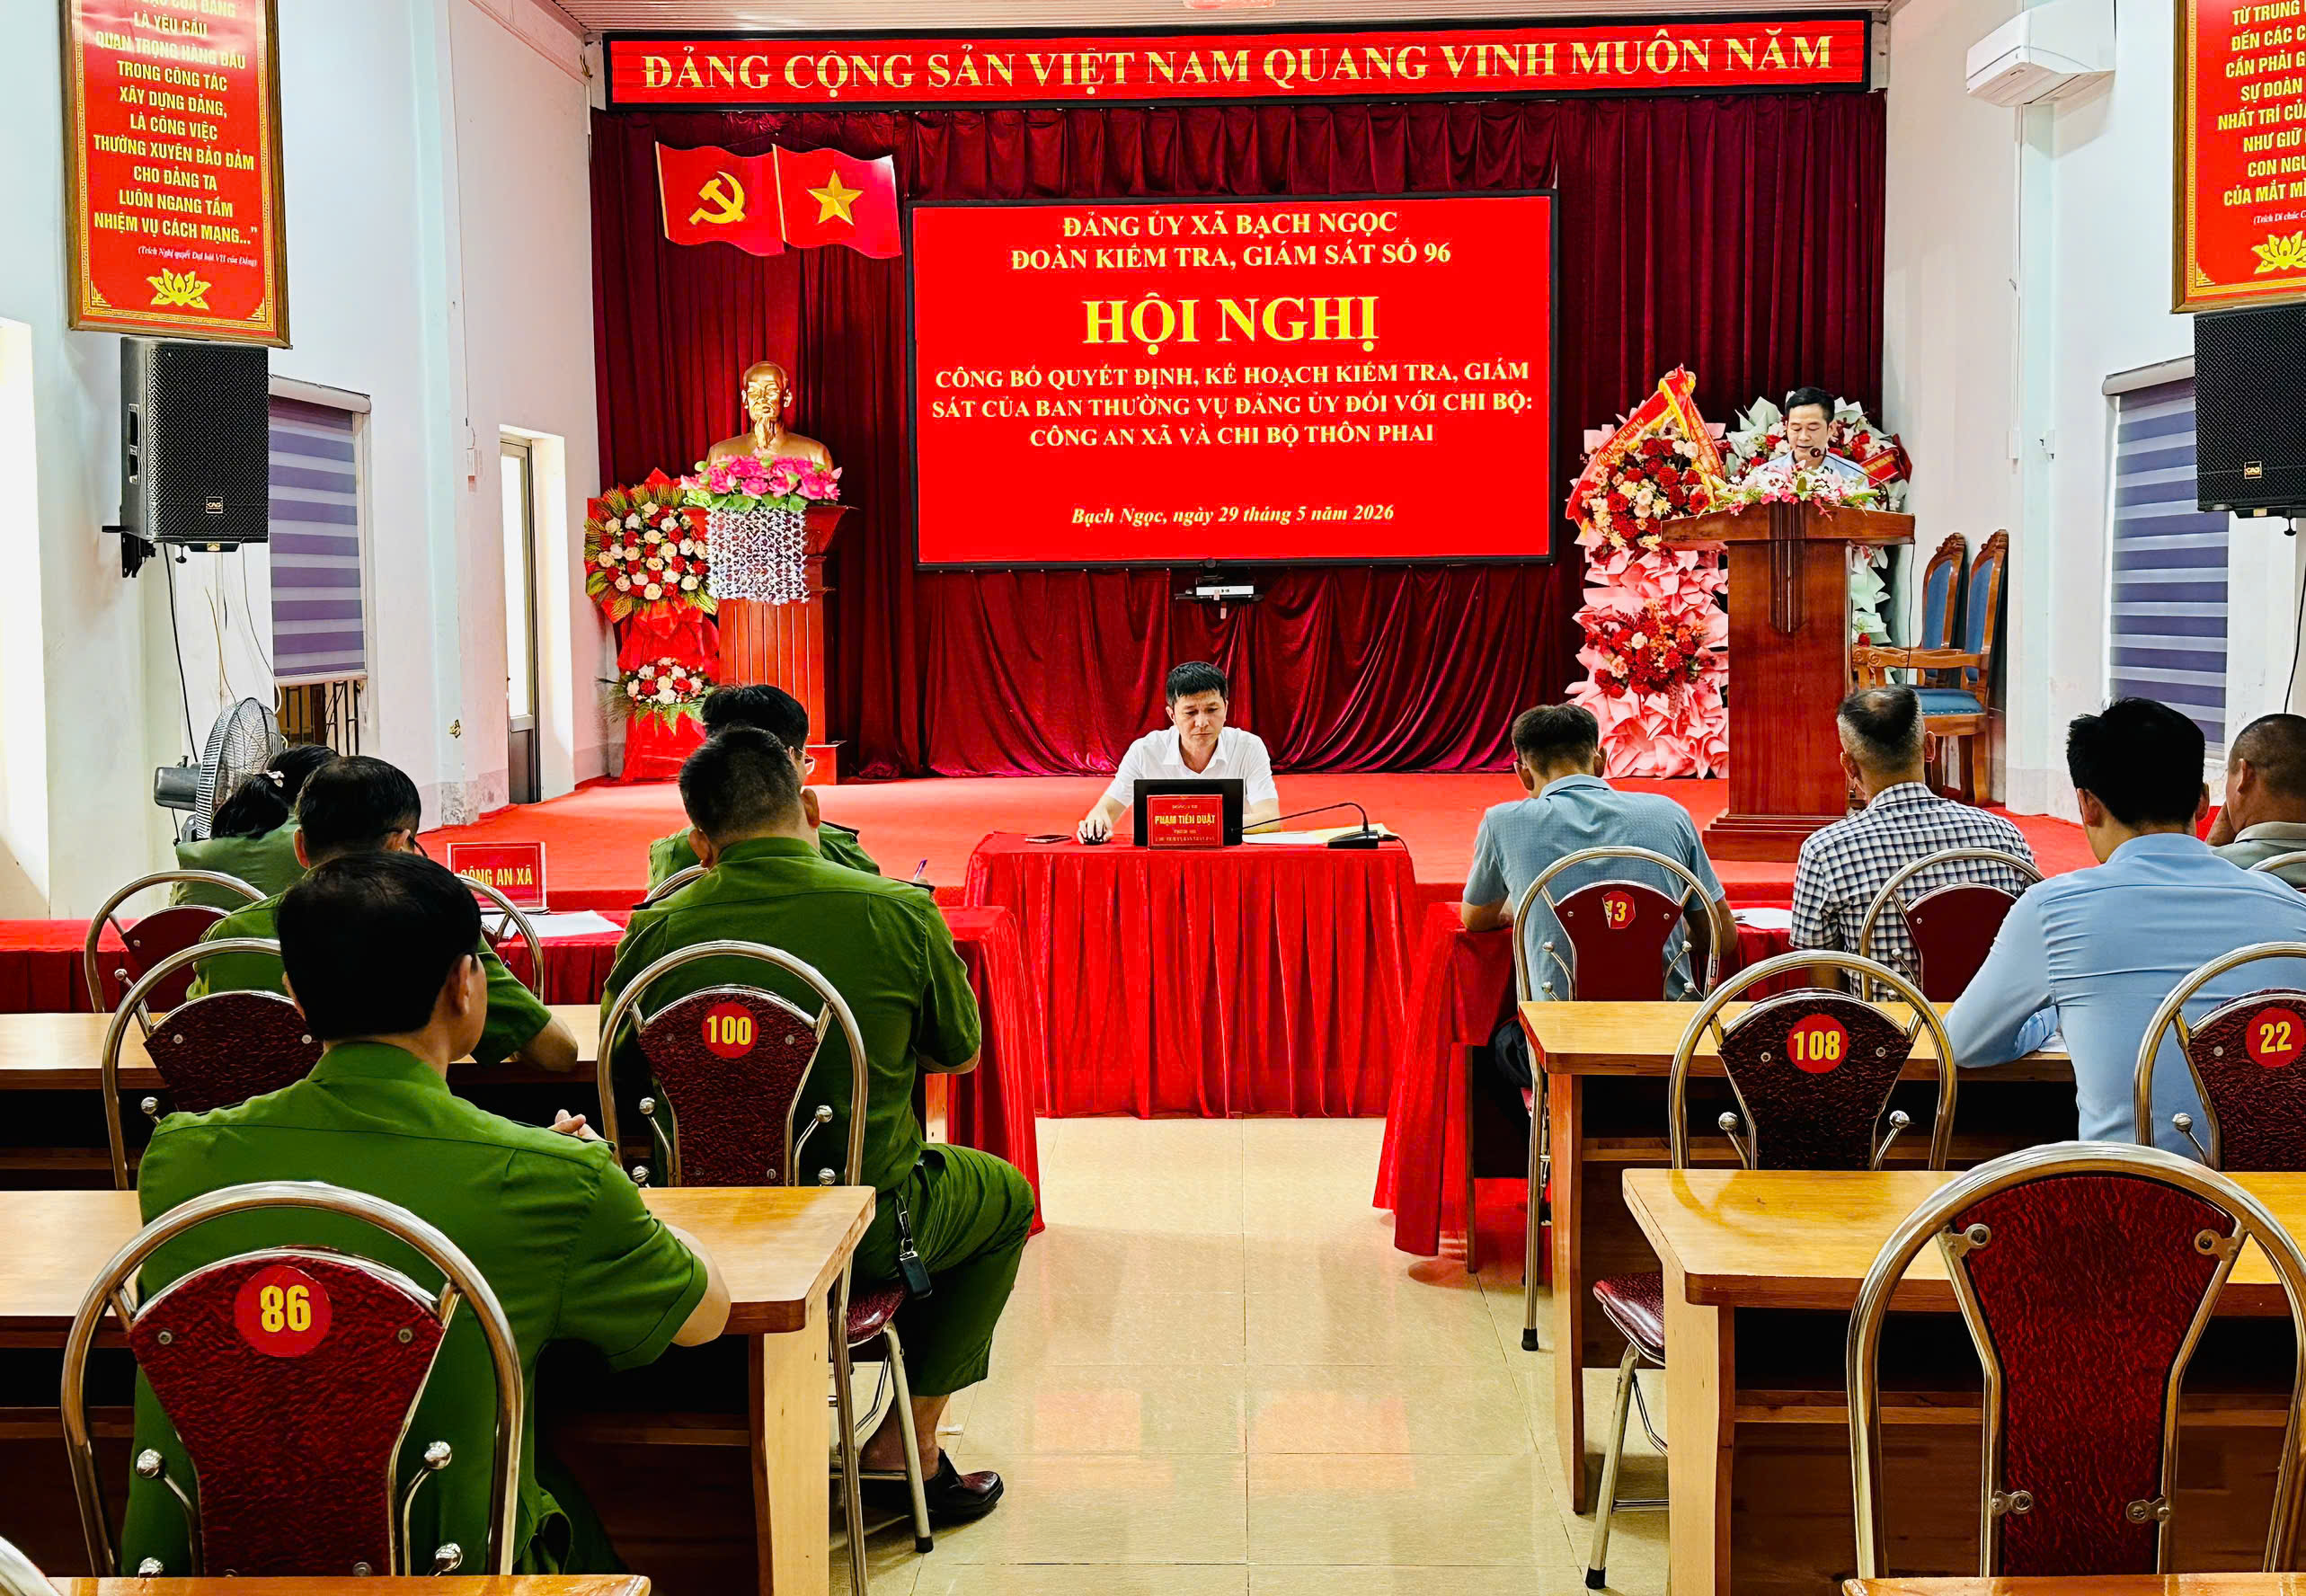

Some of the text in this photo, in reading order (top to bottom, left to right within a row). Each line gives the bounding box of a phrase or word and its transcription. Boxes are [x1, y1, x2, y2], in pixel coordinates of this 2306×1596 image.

[134, 10, 150, 28] LÀ
[154, 13, 177, 34] YÊU
[2232, 5, 2251, 25] TỪ
[2253, 0, 2300, 22] TRUNG
[95, 31, 134, 51] QUAN
[135, 37, 179, 59] TRỌNG
[2231, 29, 2259, 51] ĐẾN
[2265, 25, 2292, 46] CÁC
[642, 29, 1832, 97] ĐẢNG CỘNG SẢN VIỆT NAM QUANG VINH MUÔN NĂM
[2259, 49, 2292, 73] PHẢI
[117, 60, 227, 91] TRONG CÔNG TÁC
[2240, 76, 2302, 102] SỰ ĐOÀN
[120, 85, 227, 119] XÂY DỰNG ĐẢNG,
[130, 111, 217, 142] LÀ CÔNG VIỆC
[2218, 106, 2255, 130] NHẤT
[2258, 103, 2280, 124] TRÍ
[93, 134, 253, 170] THƯỜNG XUYÊN BẢO ĐẢM
[2243, 128, 2302, 153] NHƯ GIỮ
[134, 165, 217, 191] CHO ĐẢNG TA
[2248, 159, 2277, 177] CON
[120, 189, 153, 208] LUÔN
[157, 194, 202, 214] NGANG
[2224, 184, 2251, 206] CỦA
[94, 212, 137, 233] NHIỆM
[142, 217, 158, 237] VỤ
[163, 218, 198, 238] CÁCH
[1064, 210, 1397, 238] ĐẢNG ỦY XÃ BẠCH NGỌC
[1012, 244, 1086, 269] ĐOÀN
[1175, 248, 1236, 269] TRA,
[1244, 241, 1316, 266] GIÁM
[1326, 239, 1375, 264] SÁT
[1383, 238, 1416, 263] SỐ
[1424, 243, 1450, 262] 96
[1083, 293, 1379, 355] HỘI NGHỊ
[936, 367, 1003, 387] CÔNG
[1048, 364, 1128, 390] QUYẾT
[1136, 368, 1199, 389] ĐỊNH,
[1245, 367, 1327, 387] HOẠCH
[1405, 365, 1458, 382] TRA,
[1465, 358, 1528, 379] GIÁM
[933, 390, 1531, 419] SÁT CỦA BAN THƯỜNG VỤ ĐẢNG ỦY ĐỐI VỚI CHI BỘ:
[1031, 421, 1432, 447] CÔNG AN XÃ VÀ CHI BỘ THÔN PHAI
[1072, 505, 1393, 527] Bạch Ngọc, ngày 29 tháng 5 năm 2026
[496, 868, 513, 886] AN
[517, 864, 532, 885] XÃ
[707, 1015, 751, 1045] 100
[2260, 1021, 2292, 1053] 22
[1794, 1031, 1840, 1060] 108
[261, 1285, 311, 1333] 86
